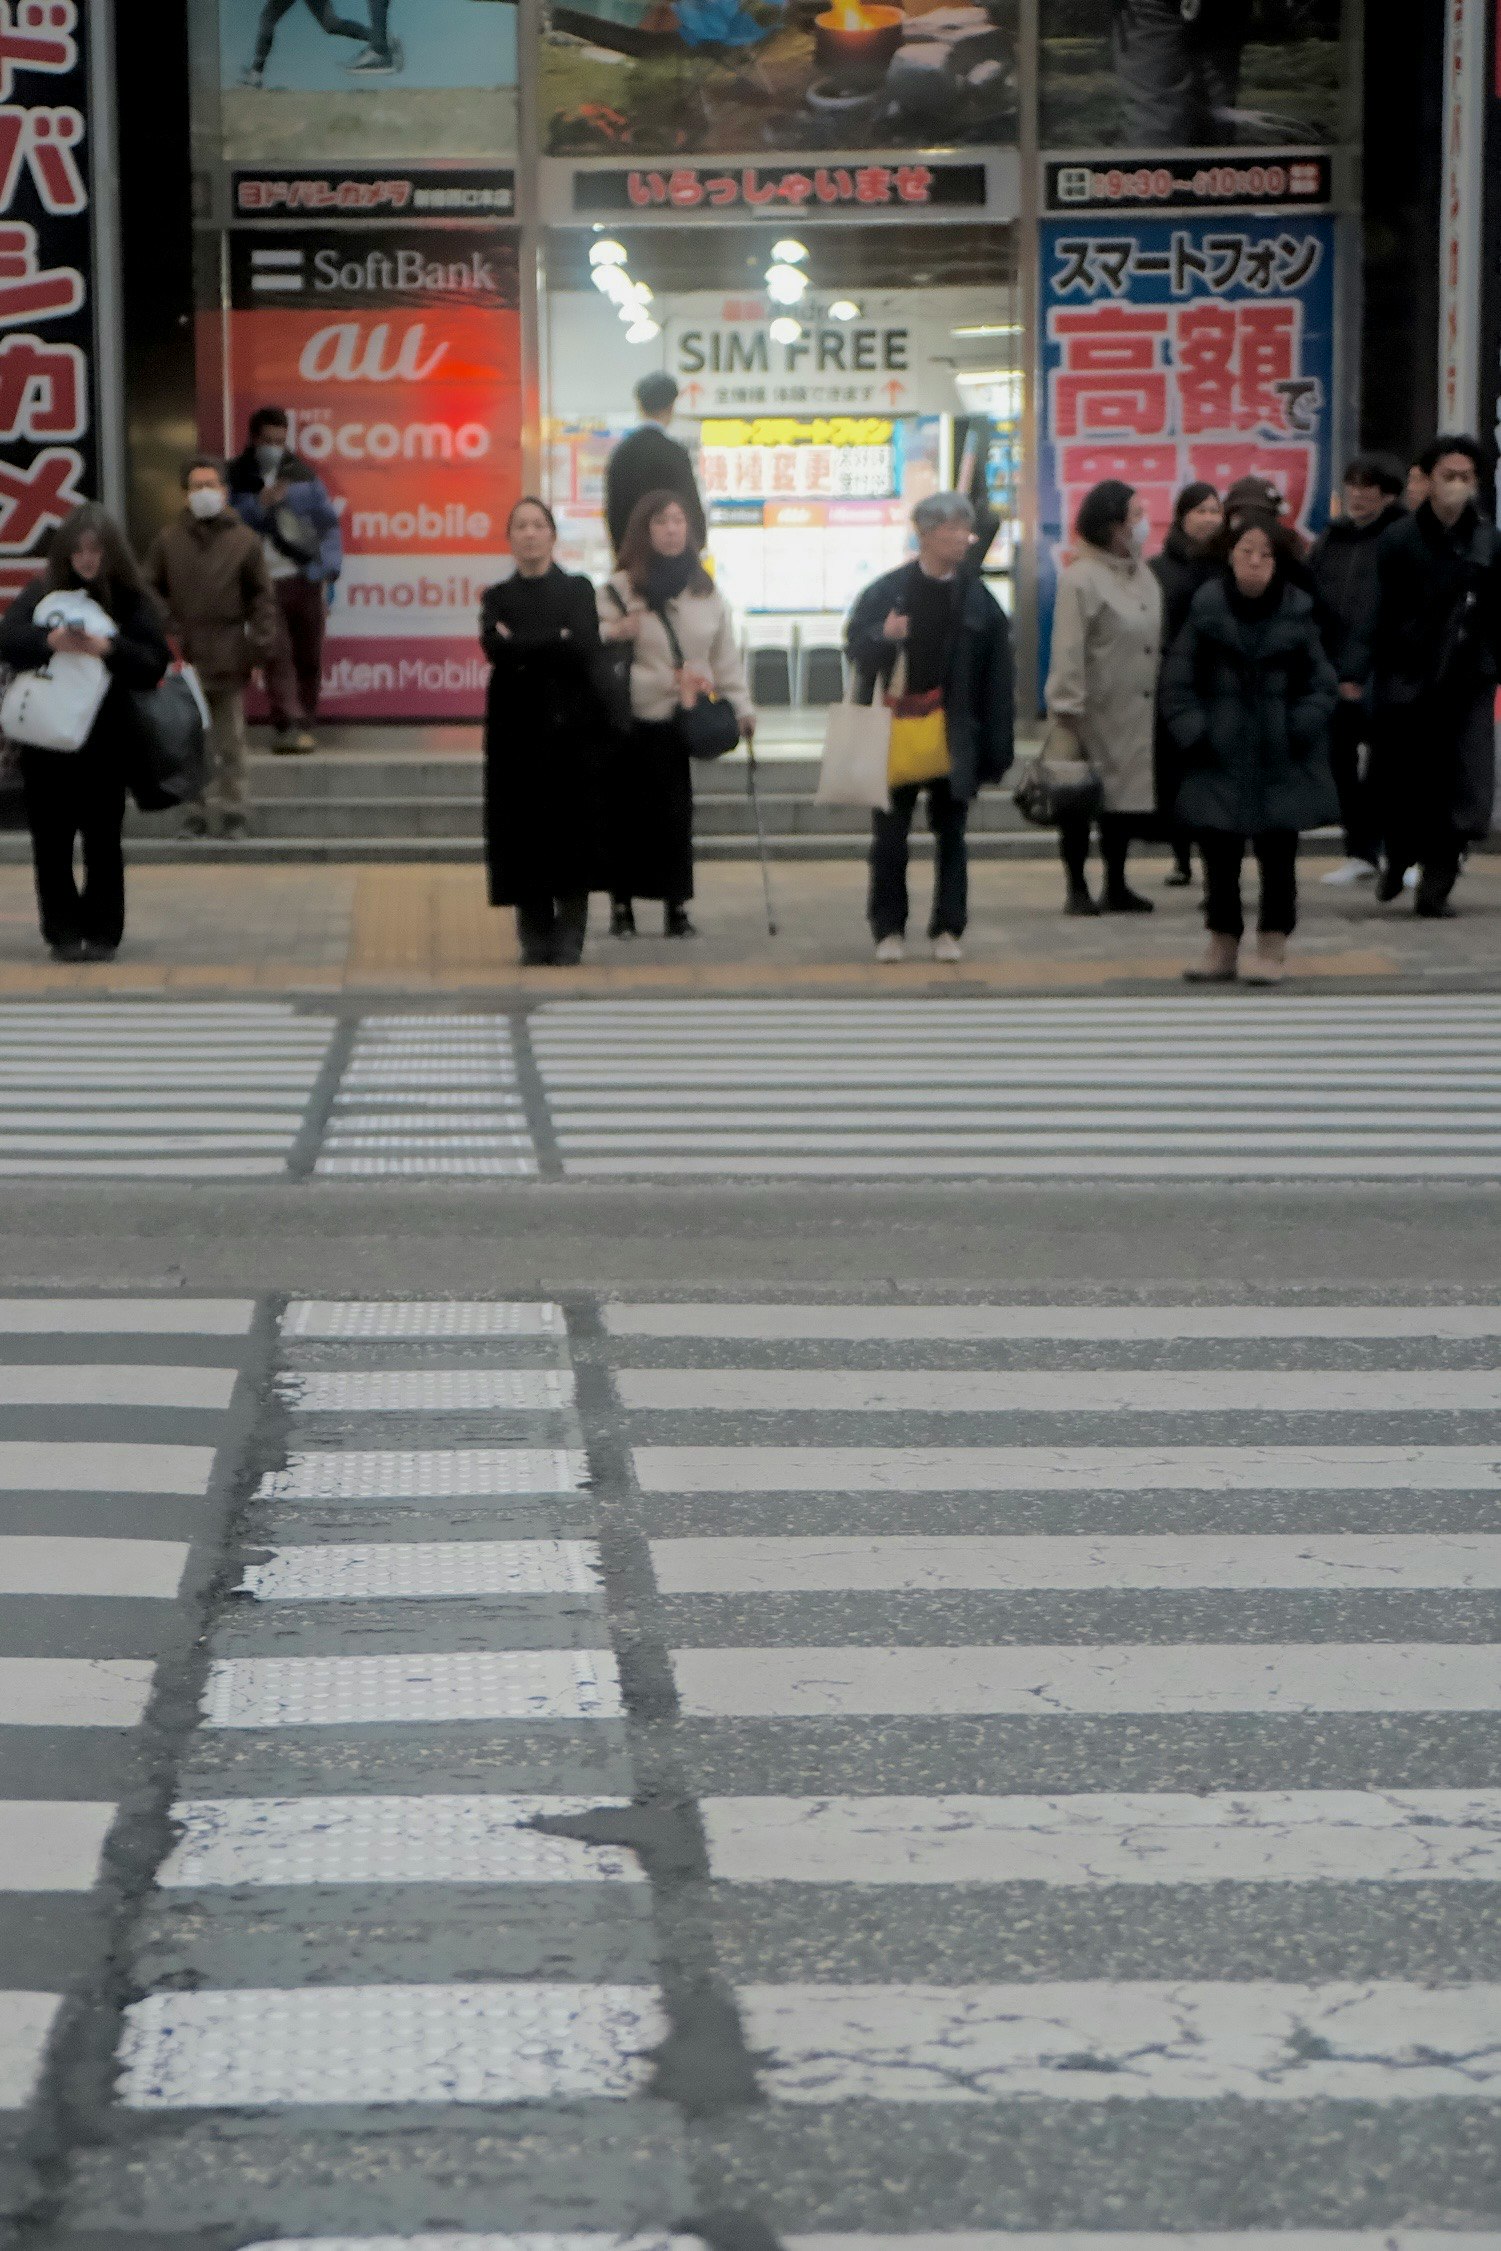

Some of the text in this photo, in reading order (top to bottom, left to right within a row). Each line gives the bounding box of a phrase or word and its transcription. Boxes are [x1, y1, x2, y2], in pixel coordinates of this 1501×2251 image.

[238, 180, 412, 208] ヨドバシカメラ
[627, 165, 934, 206] いらっしゃいませ
[313, 250, 496, 291] SoftBank
[1052, 231, 1322, 295] スマートフォン
[0, 0, 88, 612] ドバシカメ
[299, 322, 449, 381] au
[678, 327, 909, 373] SIM FREE
[333, 497, 490, 540] mobile
[320, 658, 393, 694] uten
